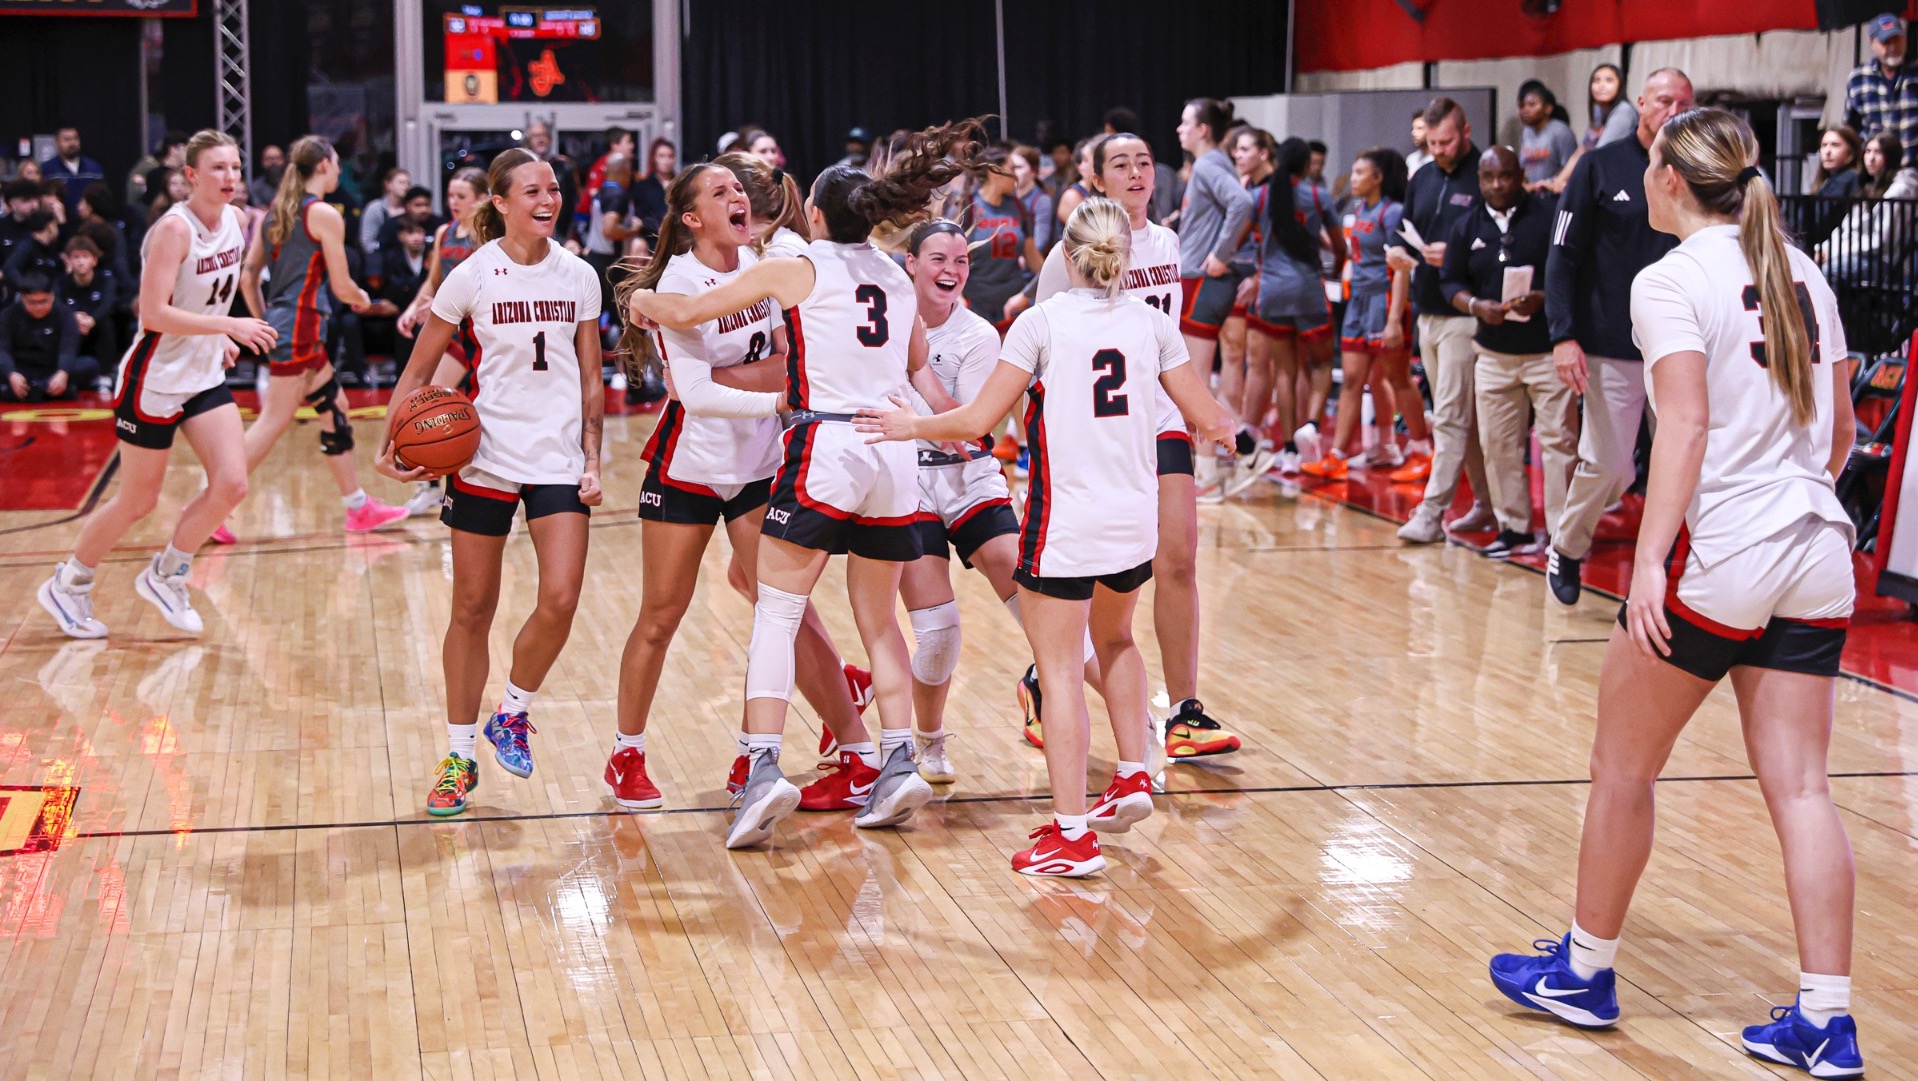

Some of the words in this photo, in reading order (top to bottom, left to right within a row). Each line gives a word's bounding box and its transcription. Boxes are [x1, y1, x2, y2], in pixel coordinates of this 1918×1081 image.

[990, 231, 1018, 259] 12
[205, 273, 234, 306] 14
[492, 301, 532, 325] ARIZONA
[717, 310, 749, 335] ARIZONA
[855, 283, 890, 348] 3
[532, 331, 549, 371] 1
[1091, 348, 1129, 418] 2
[116, 417, 137, 434] ACU
[413, 407, 472, 436] SPALDING
[639, 491, 662, 507] ACU
[766, 506, 791, 525] ACU
